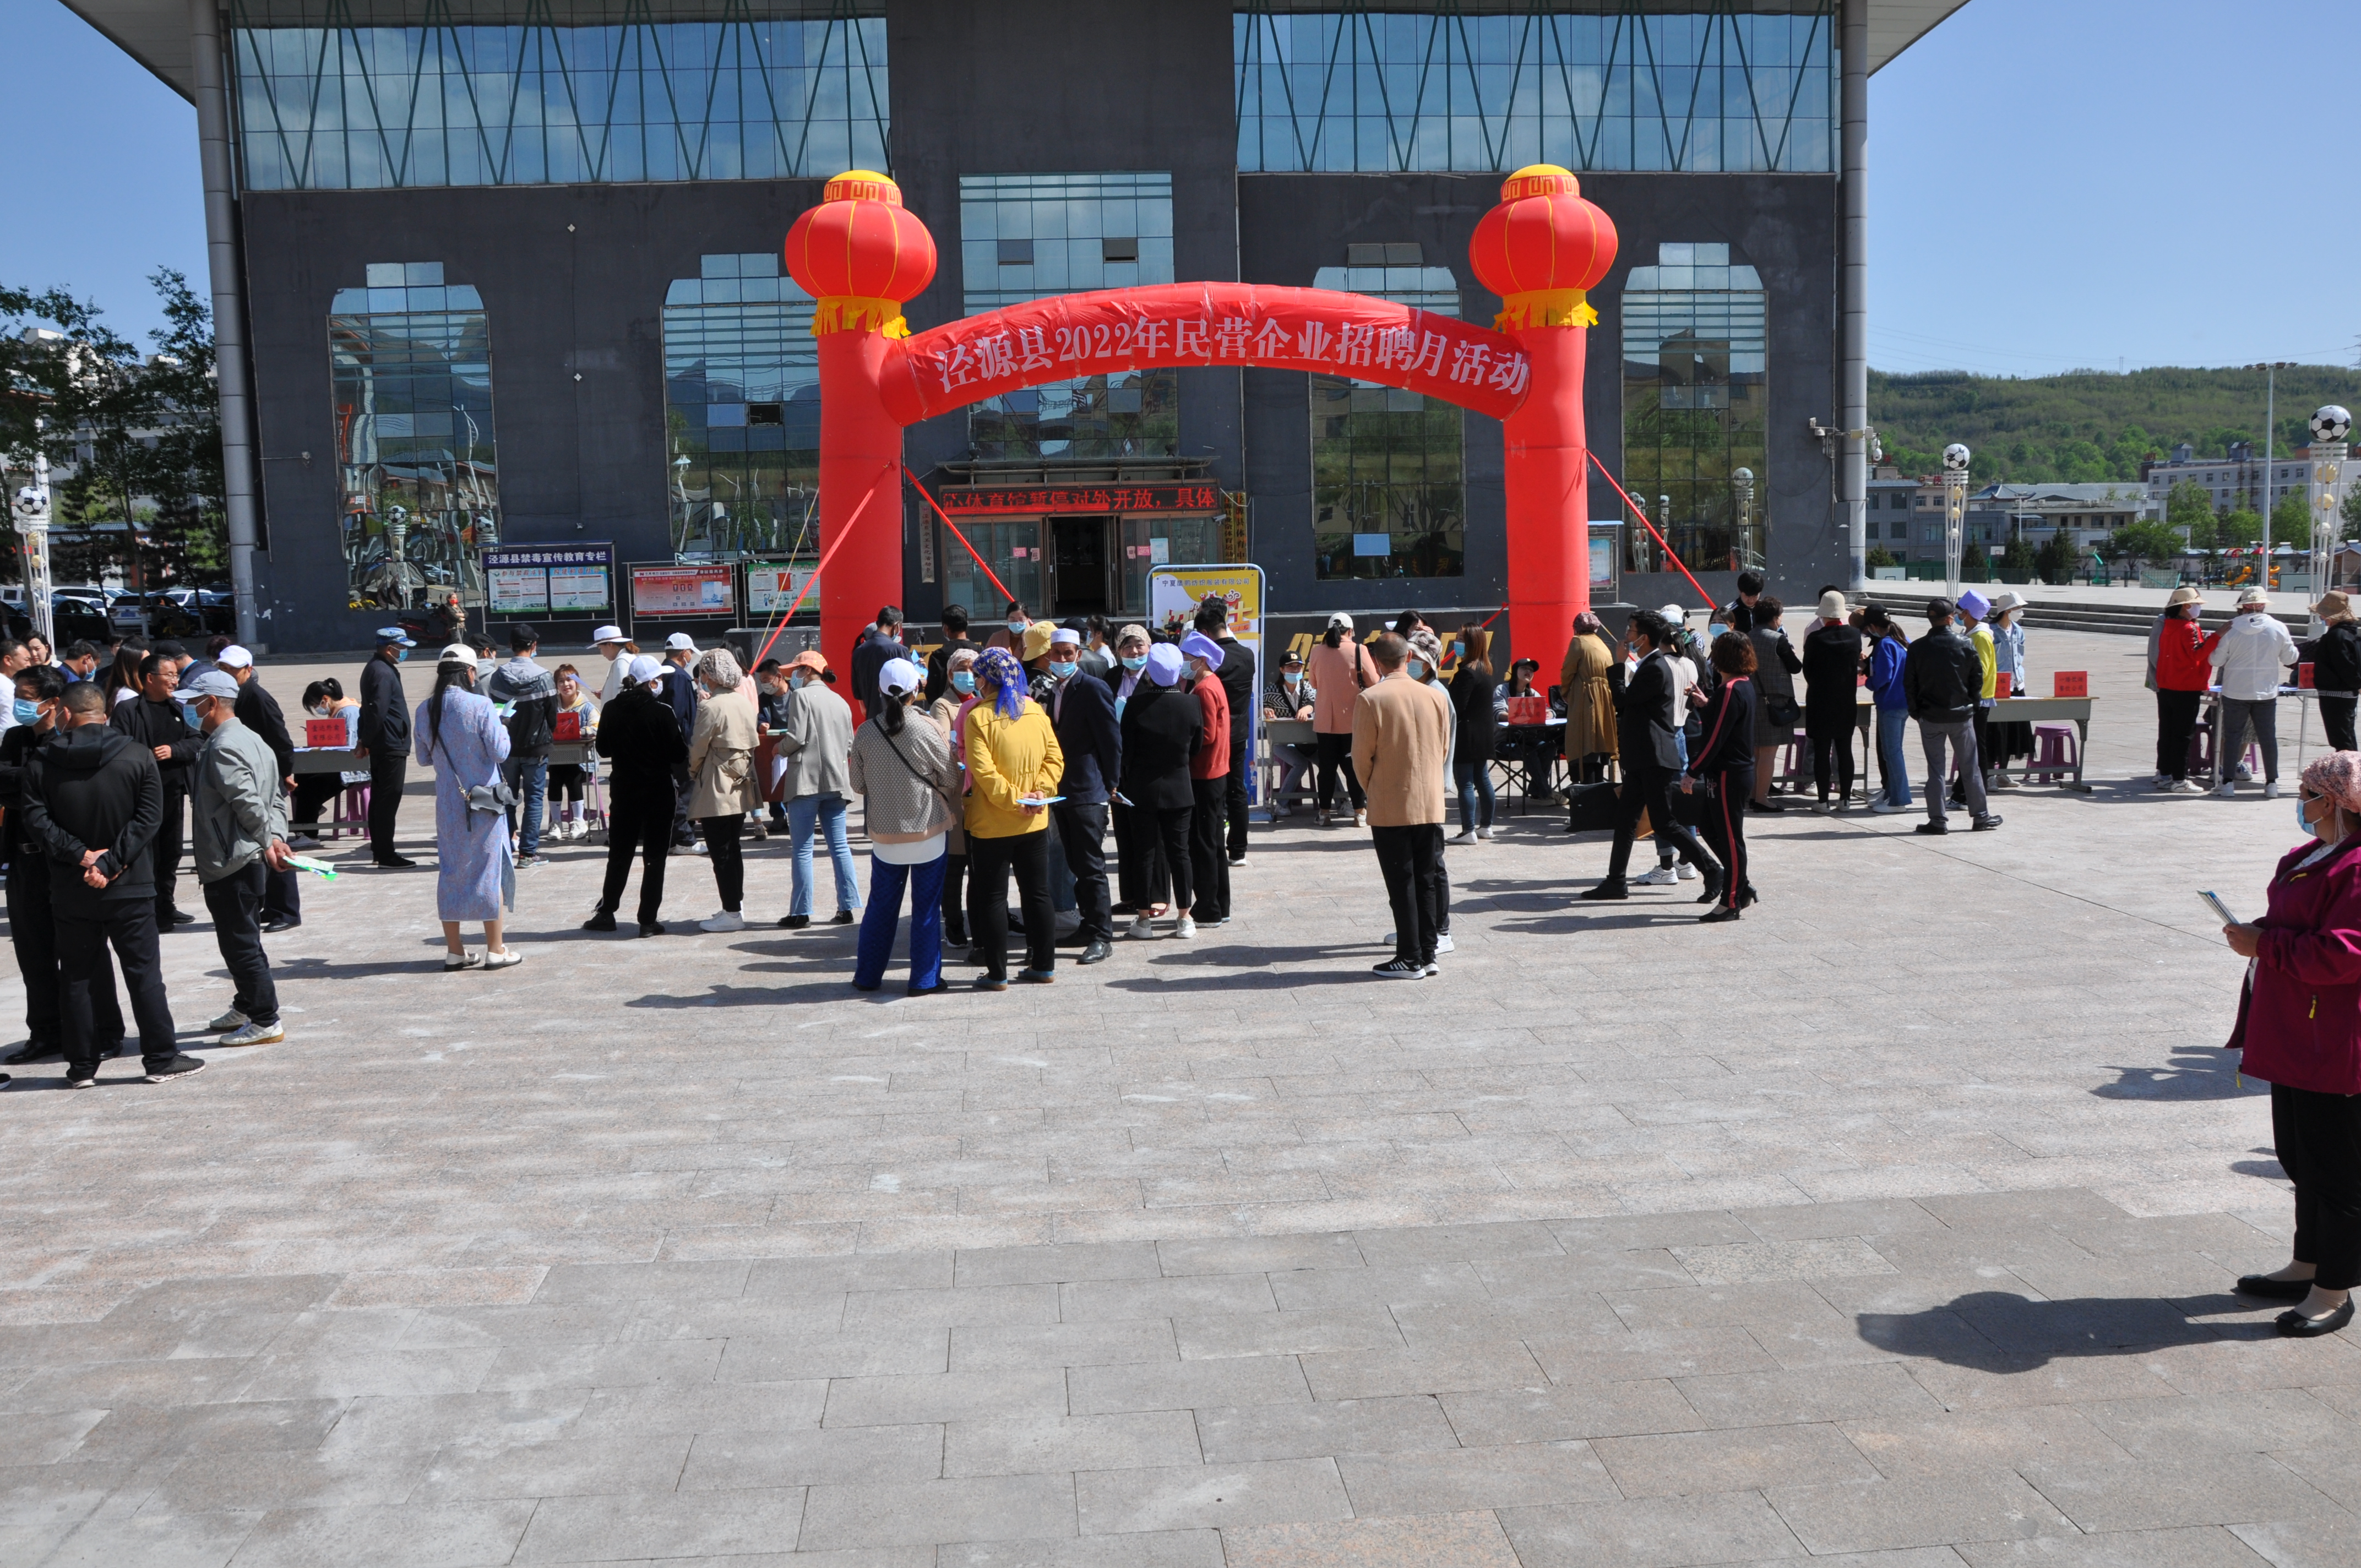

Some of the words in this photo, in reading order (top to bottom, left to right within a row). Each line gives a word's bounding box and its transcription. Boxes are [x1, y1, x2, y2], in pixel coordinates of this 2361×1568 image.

[934, 315, 1529, 395] 泾源县2022年民营企业招聘月活动
[488, 551, 607, 564] 泾源县禁毒宣传教育专栏
